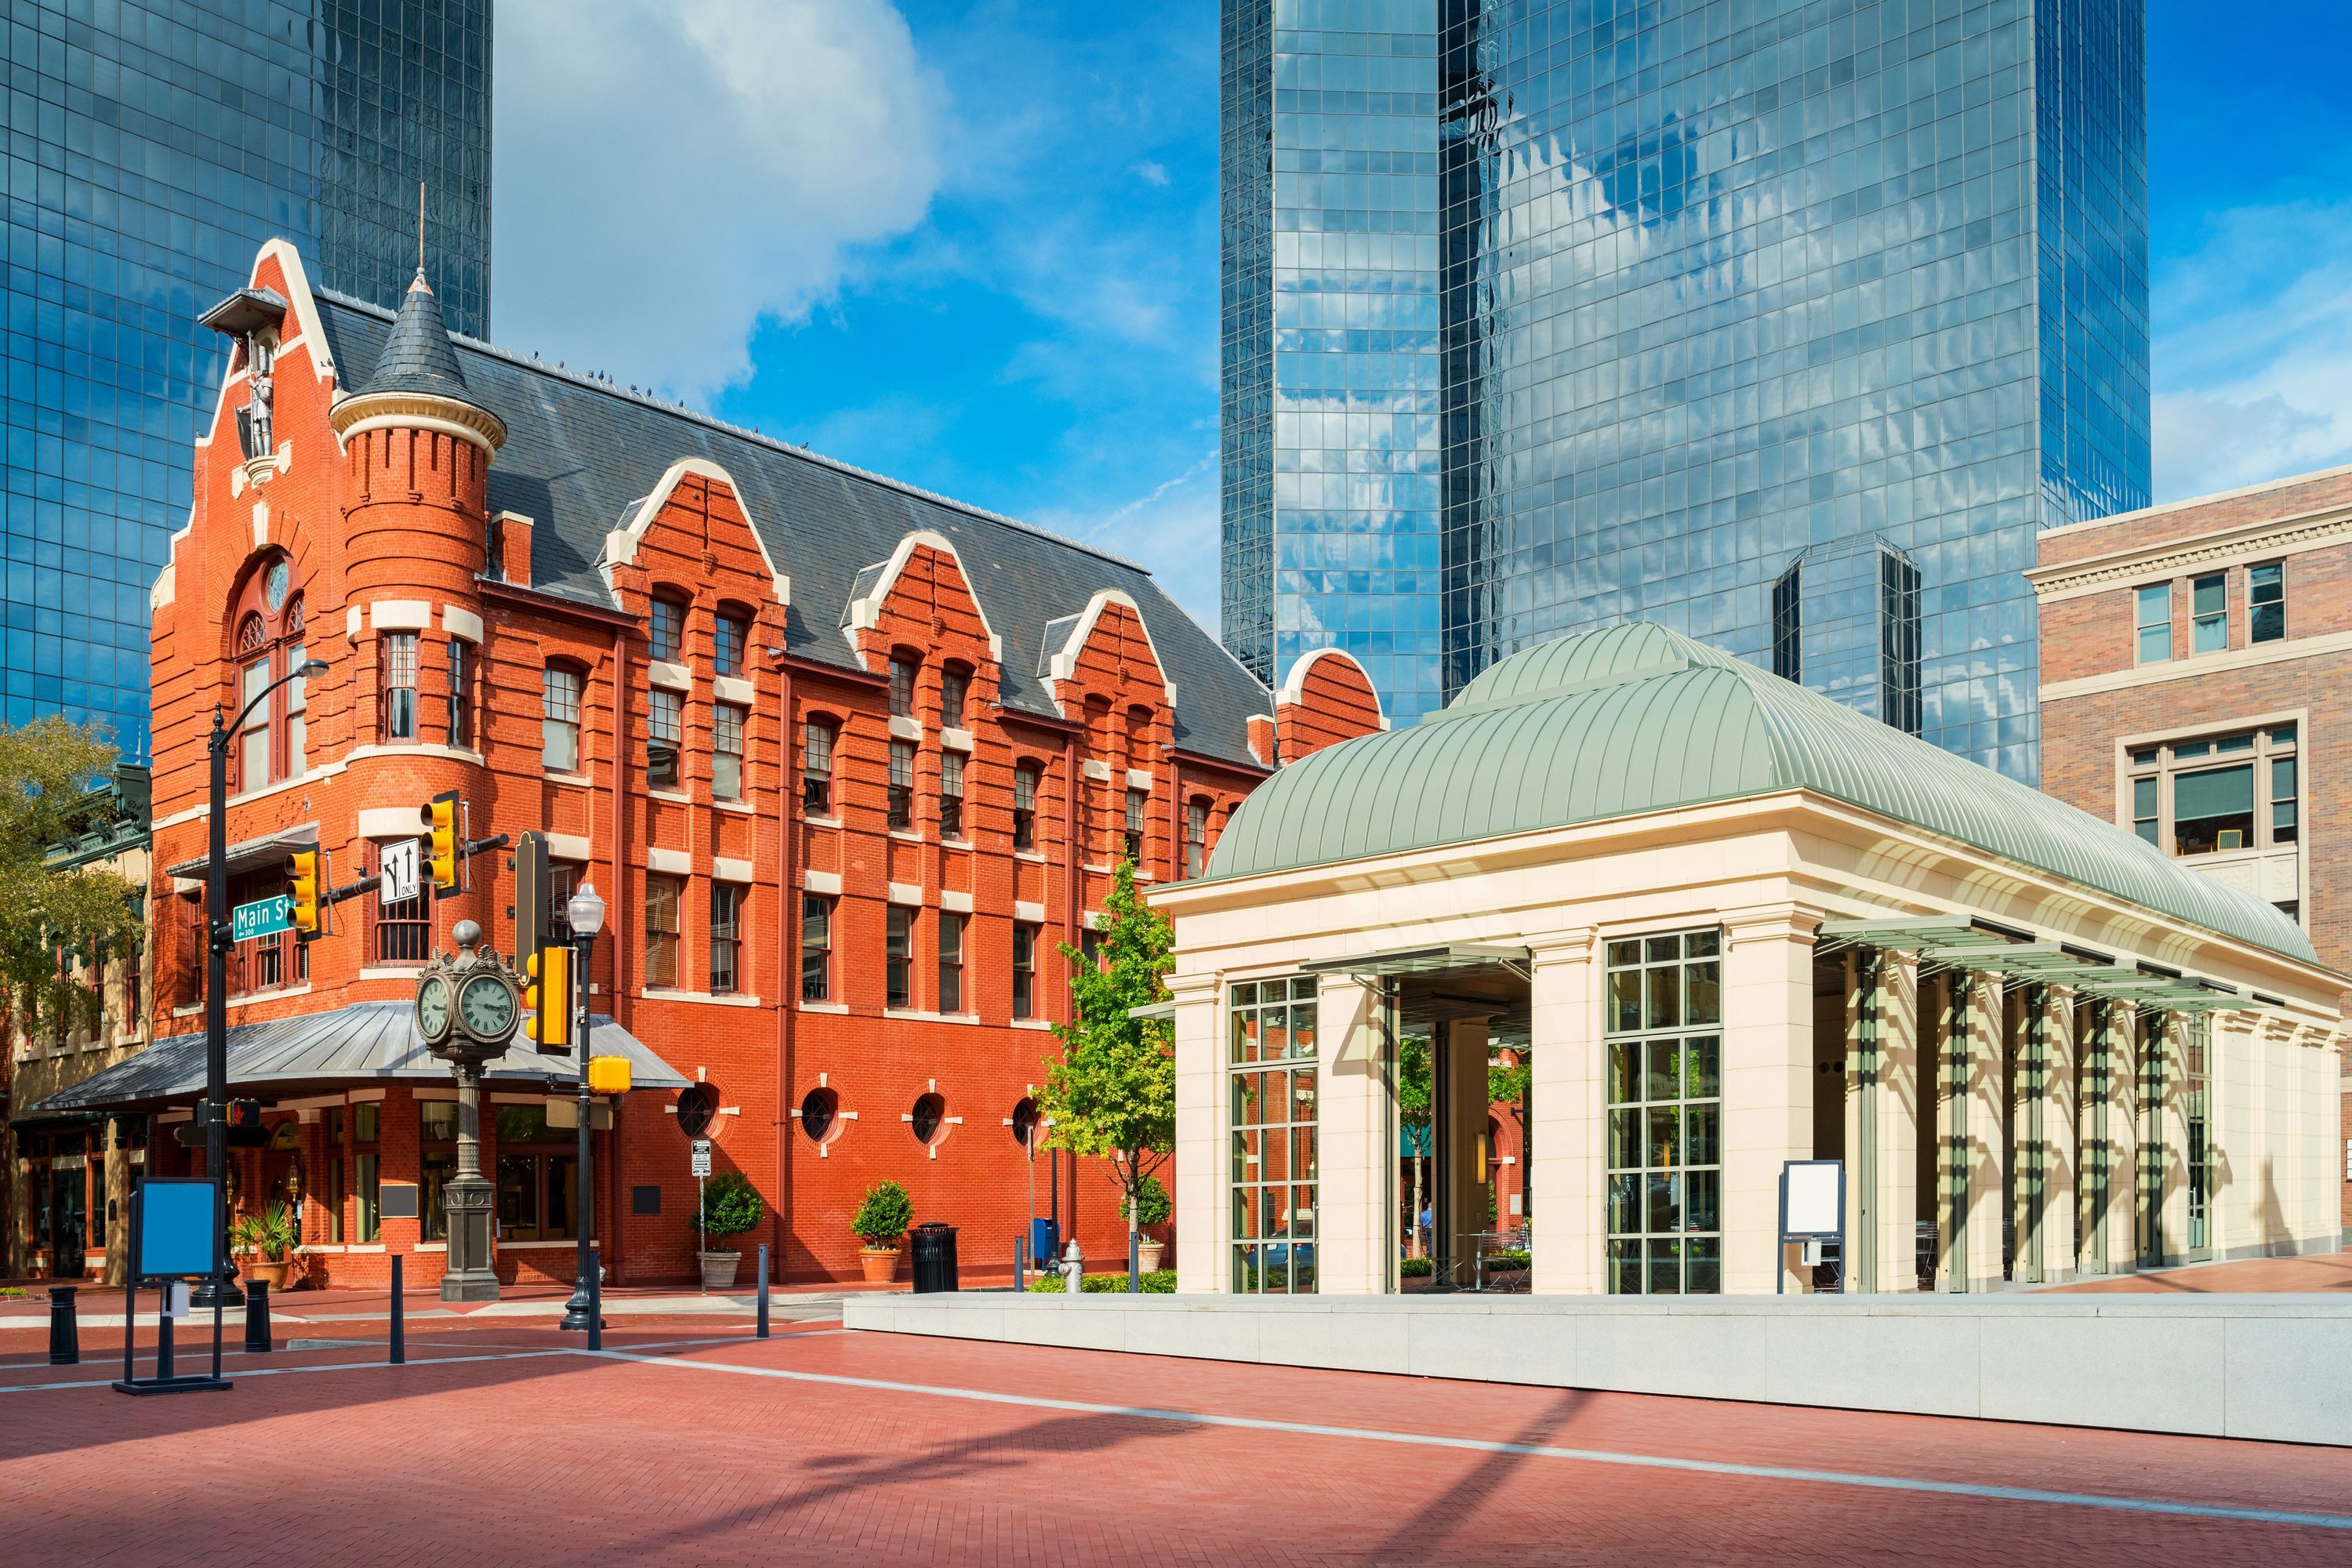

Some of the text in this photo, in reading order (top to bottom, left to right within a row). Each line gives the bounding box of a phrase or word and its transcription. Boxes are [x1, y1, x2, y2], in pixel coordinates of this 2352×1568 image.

[401, 883, 416, 895] ONLY
[238, 899, 289, 930] Main St
